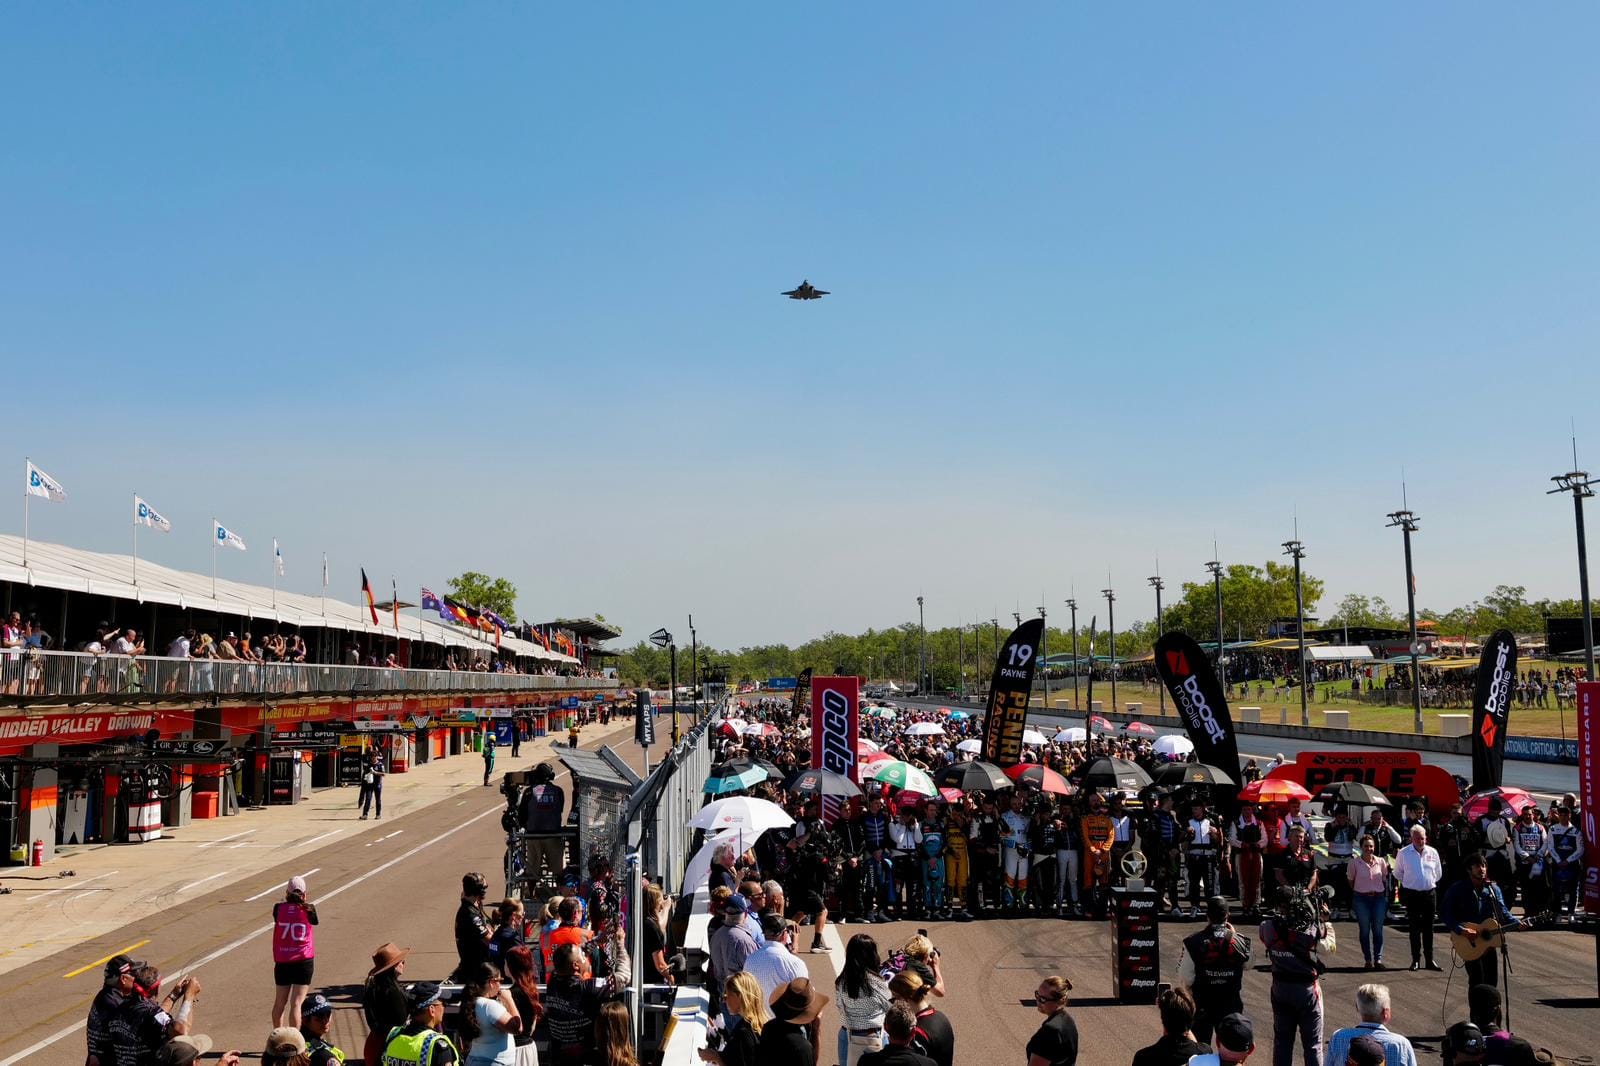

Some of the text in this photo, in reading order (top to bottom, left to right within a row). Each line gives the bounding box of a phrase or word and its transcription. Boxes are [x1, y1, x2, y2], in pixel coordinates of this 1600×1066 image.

[1008, 643, 1033, 667] 19
[1000, 668, 1028, 679] PAYNE
[1485, 642, 1510, 713] boost
[1496, 670, 1511, 718] mobile
[283, 706, 306, 718] VALLEY
[1173, 684, 1201, 729] mobile
[1183, 674, 1226, 745] boost
[52, 717, 103, 734] VALLEY
[107, 715, 153, 731] DARWIN
[498, 726, 508, 737] 7
[643, 704, 652, 743] MYLAPS
[822, 688, 854, 777] epco
[988, 690, 1006, 759] RACING
[1530, 741, 1558, 757] CRITICAL
[1583, 692, 1593, 807] SUPERCARS
[1328, 756, 1365, 766] boost
[1304, 768, 1418, 794] POLE
[1129, 900, 1154, 908] Repco
[278, 922, 307, 941] 70
[1130, 939, 1155, 947] Repco
[1131, 979, 1156, 987] Repco
